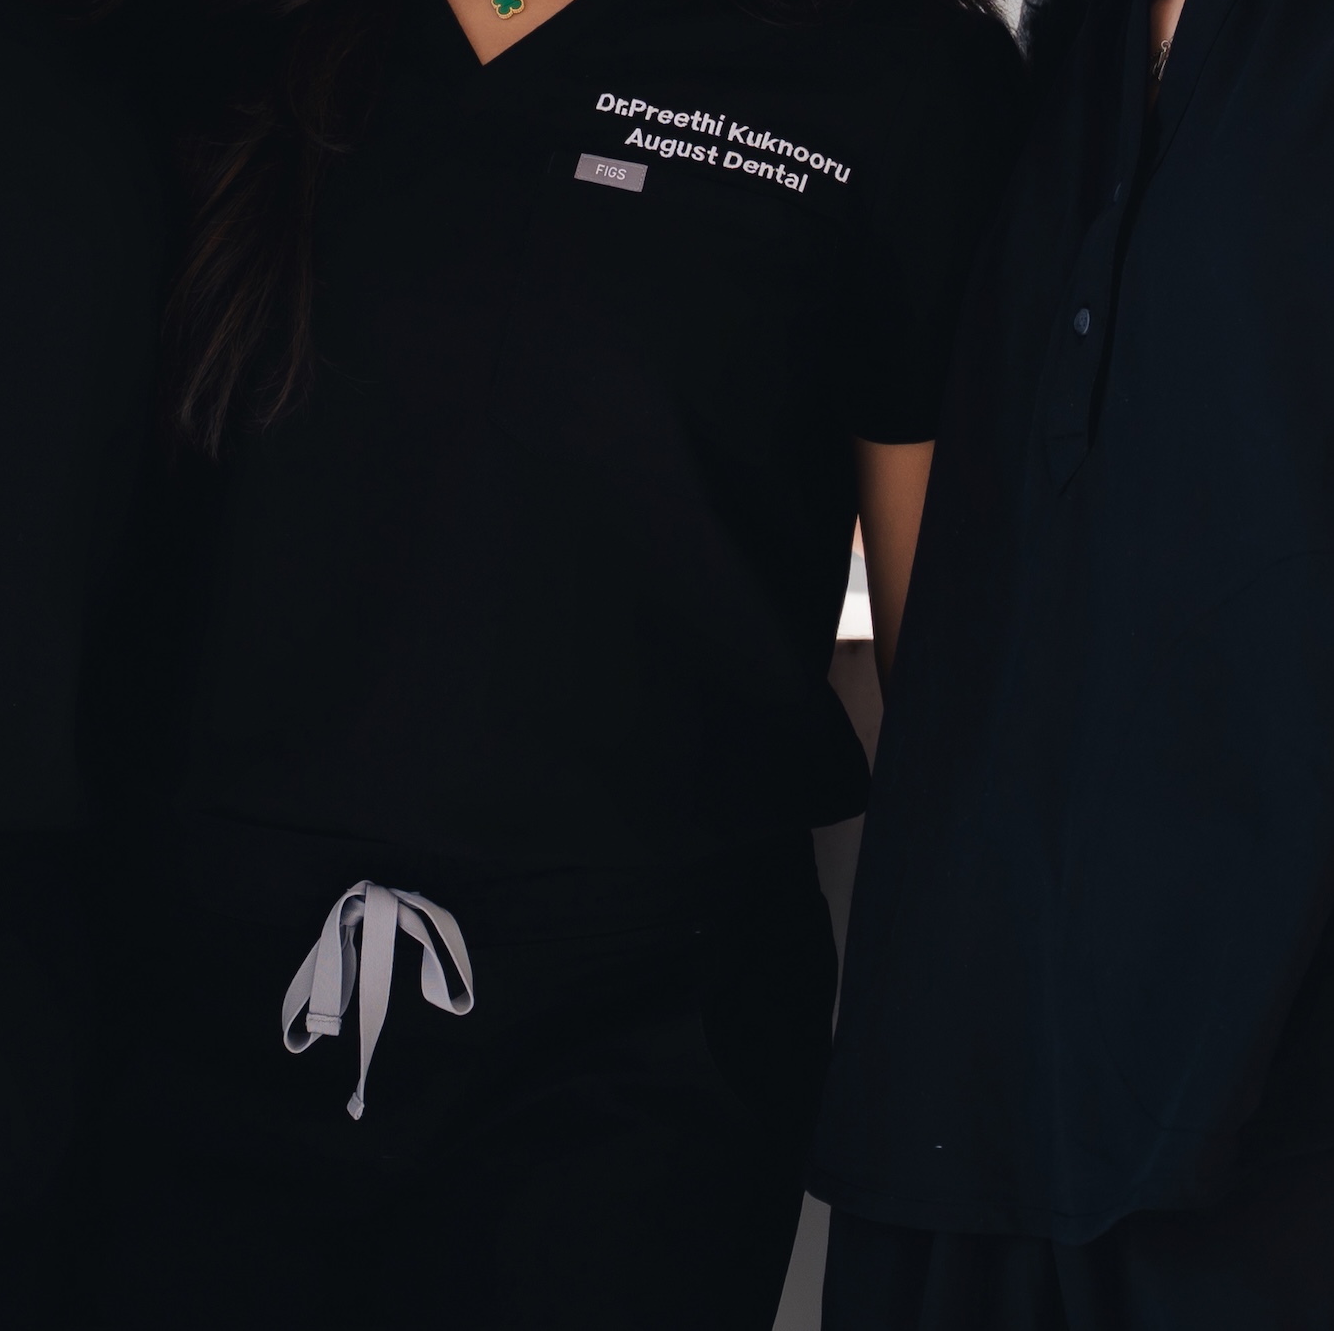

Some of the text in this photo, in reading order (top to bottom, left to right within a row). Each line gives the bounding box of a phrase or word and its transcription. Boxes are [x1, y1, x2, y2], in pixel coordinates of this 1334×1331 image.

[595, 163, 627, 181] FIGS
[624, 127, 809, 193] August Dental
[728, 121, 851, 183] Kuknooru
